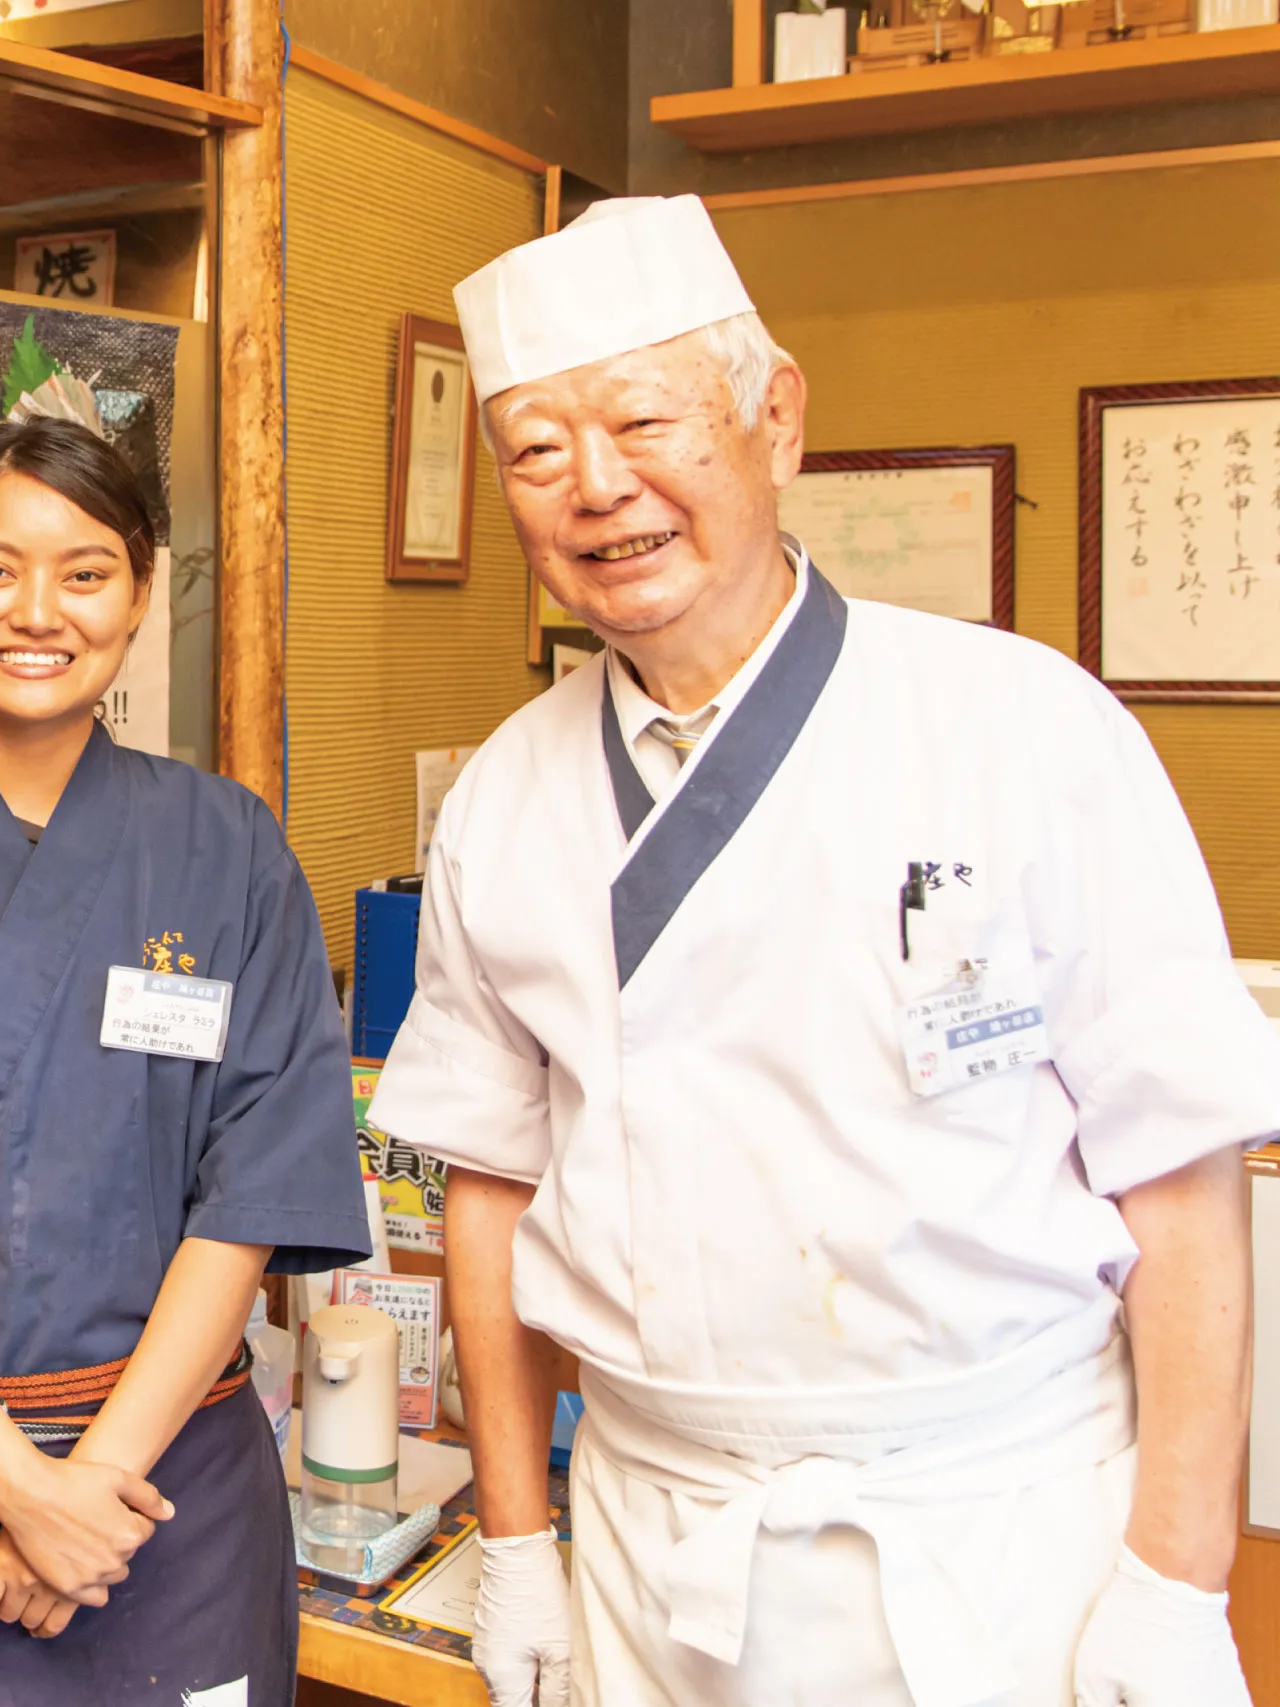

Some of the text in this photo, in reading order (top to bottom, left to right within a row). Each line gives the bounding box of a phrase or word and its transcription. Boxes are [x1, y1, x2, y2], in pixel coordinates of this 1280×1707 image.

[112, 1018, 170, 1035] 行為の結果が
